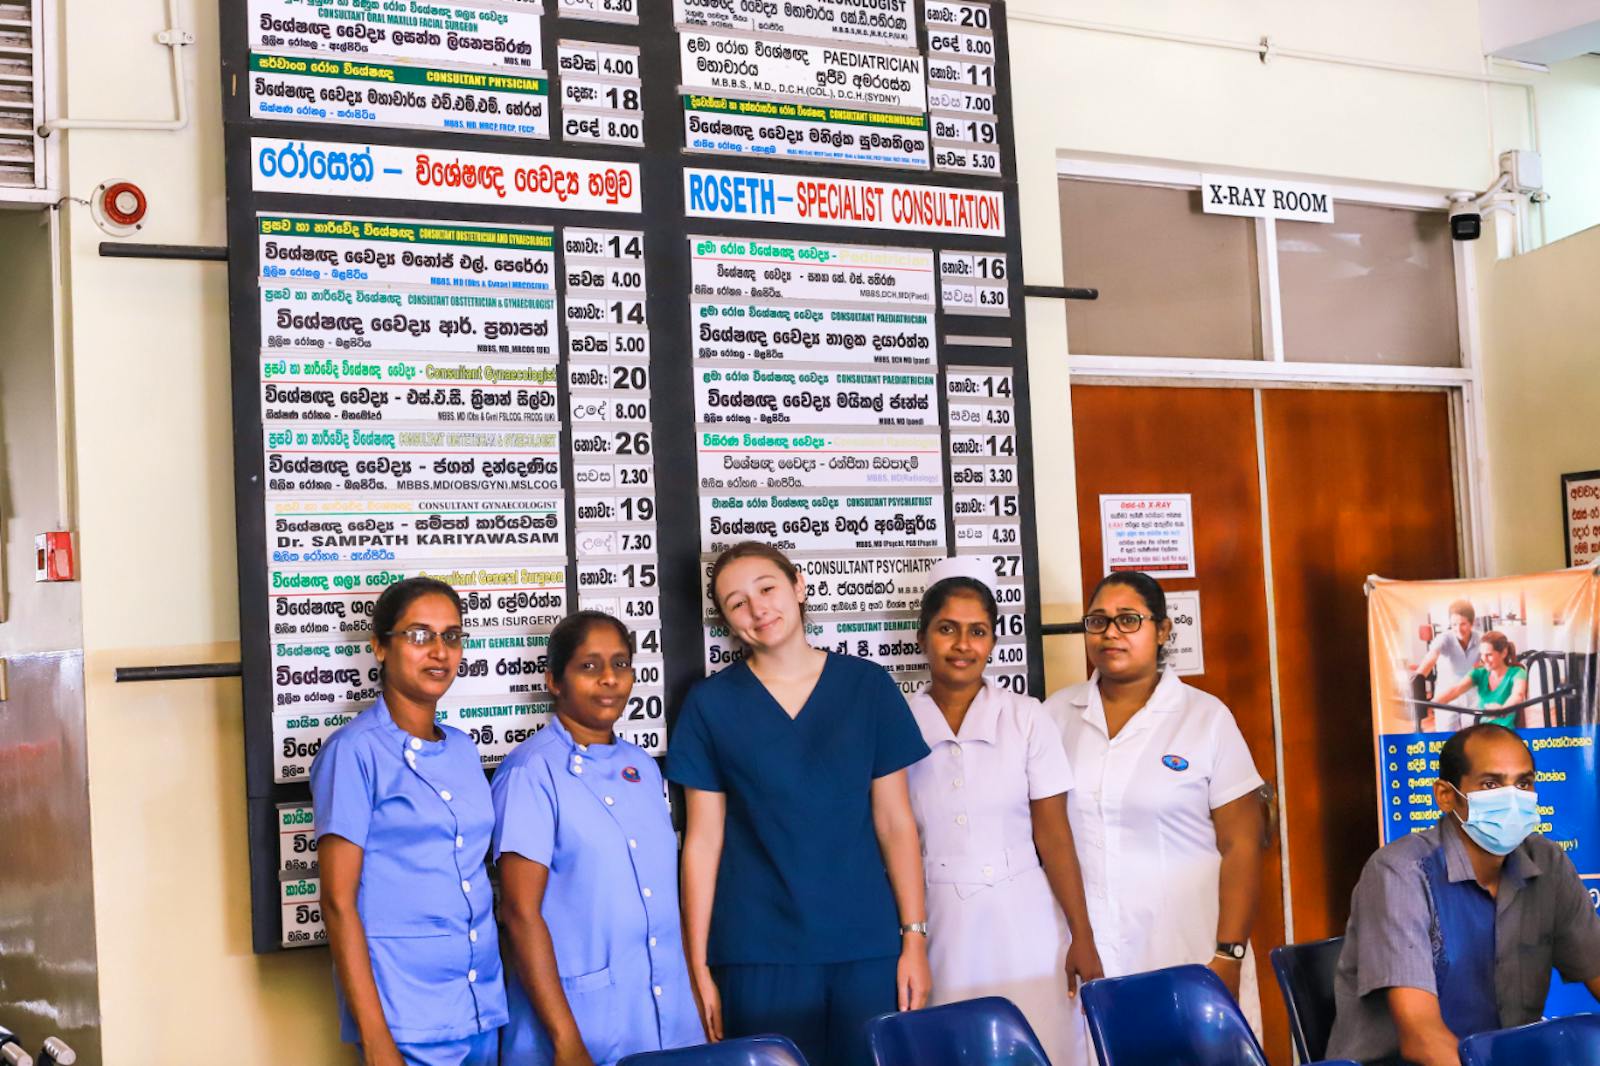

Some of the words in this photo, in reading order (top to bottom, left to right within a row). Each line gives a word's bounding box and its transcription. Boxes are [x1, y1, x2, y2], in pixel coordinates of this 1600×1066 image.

[318, 8, 365, 22] CONSULTANT
[367, 12, 385, 23] ORAL
[419, 16, 444, 29] FACIAL
[445, 19, 478, 32] SURGEON
[959, 7, 988, 28] 20
[260, 14, 331, 38] විශේෂඥ
[336, 24, 385, 43] වෛද්‍ය
[931, 35, 960, 52] උදේ
[966, 39, 992, 54] 8.00
[560, 54, 596, 72] සවස
[603, 58, 633, 74] 4.00
[687, 37, 710, 52] ළමා
[716, 40, 748, 56] රෝග
[755, 41, 810, 66] විශේෂඥ
[824, 50, 919, 74] PAEDIATRICIAN
[343, 62, 395, 81] විශේෂඥ
[426, 71, 486, 86] CONSULTANT
[488, 77, 539, 91] PHYSICIAN
[967, 65, 992, 86] 11
[255, 78, 315, 102] විශේෂඥ
[320, 86, 362, 106] වෛද්‍ය
[605, 87, 639, 111] 18
[965, 96, 991, 111] 7.00
[566, 118, 600, 137] උදේ
[608, 122, 639, 139] 8.00
[689, 116, 754, 141] විශේෂඥ
[759, 126, 803, 145] වෛද්‍ය
[967, 122, 994, 143] 19
[936, 152, 966, 166] සවස
[973, 154, 995, 169] 5.30
[258, 143, 374, 183] රෝසෙත්
[415, 154, 505, 197] විශේෂඥ
[514, 163, 579, 205] වෛද්‍ය
[589, 169, 633, 204] හමුව
[690, 174, 775, 215] ROSETH
[797, 181, 884, 221] SPECIALIST
[891, 188, 1000, 230] CONSULTATION
[1209, 184, 1266, 208] X-RAY
[1273, 190, 1329, 213] ROOM
[265, 241, 339, 266] විශේෂඥ
[344, 249, 396, 268] වෛද්‍ය
[494, 257, 548, 274] පෙරේරා
[607, 235, 642, 259] 14
[977, 257, 1005, 280] 16
[568, 271, 604, 286] සවස
[611, 272, 641, 288] 4.00
[407, 294, 449, 307] CONSULTANT
[450, 295, 497, 308] OBSTETRICIAN
[503, 297, 554, 310] GYNAECOLOGIST
[980, 291, 1004, 305] 6.30
[277, 308, 364, 335] විශේෂඥ
[371, 315, 431, 336] වෛද්‍ය
[610, 301, 644, 324] 14
[831, 312, 875, 322] CONSULTANT
[876, 313, 927, 324] PAEDIATRICIAN
[571, 336, 608, 352] සවස
[615, 337, 645, 352] 5.00
[700, 323, 768, 346] විශේෂඥ
[773, 328, 820, 348] වෛද්‍ය
[613, 366, 646, 389] 20
[836, 374, 881, 384] CONSULTANT
[883, 375, 934, 385] PAEDIATRICIAN
[983, 377, 1011, 398] 14
[265, 384, 336, 407] විශේෂඥ
[340, 387, 389, 408] වෛද්‍ය
[708, 389, 778, 411] විශේෂඥ
[783, 391, 831, 411] වෛද්‍ය
[574, 401, 607, 420] උදේ
[615, 404, 646, 419] 8.00
[987, 410, 1010, 424] 4.30
[615, 432, 650, 455] 26
[986, 435, 1014, 456] 14
[269, 454, 350, 476] විශේෂඥ
[356, 457, 411, 476] වෛද්‍ය
[724, 456, 775, 473] විශේෂඥ
[778, 457, 816, 473] වෛද්‍ය
[620, 468, 648, 484] 2.30
[953, 469, 983, 483] සවස
[990, 469, 1012, 483] 3.30
[418, 501, 479, 511] CONSULTANT
[482, 501, 557, 510] GYNAECOLOGIST
[620, 498, 653, 521] 19
[846, 497, 887, 507] CONSULTANT
[888, 496, 932, 507] PSYCHIATRIST
[989, 495, 1017, 516] 15
[276, 519, 343, 534] විශේෂඥ
[348, 520, 394, 533] වෛද්‍ය
[415, 515, 469, 530] සම්පත්
[710, 516, 778, 537] විශේෂඥ
[783, 516, 829, 536] වෛද්‍ය
[277, 536, 304, 548] Dr.
[311, 535, 408, 547] SAMPATH
[417, 532, 559, 545] KARIYAWASAM
[622, 534, 651, 550] 7.30
[992, 529, 1016, 543] 4.30
[622, 564, 656, 588] 15
[992, 555, 1020, 577] 27
[272, 571, 328, 590] විශේෂඥ
[996, 588, 1021, 603] 8.00
[276, 597, 346, 617] විශේෂඥ
[626, 601, 653, 616] 4.30
[837, 622, 882, 633] CONSULTANT
[997, 615, 1023, 635] 16
[276, 643, 331, 657] විශේෂඥ
[489, 636, 525, 648] GENERAL
[998, 648, 1023, 663] 4.00
[276, 665, 362, 687] විශේෂඥ
[997, 675, 1026, 694] 20
[459, 706, 513, 719] CONSULTANT
[628, 696, 662, 720] 20
